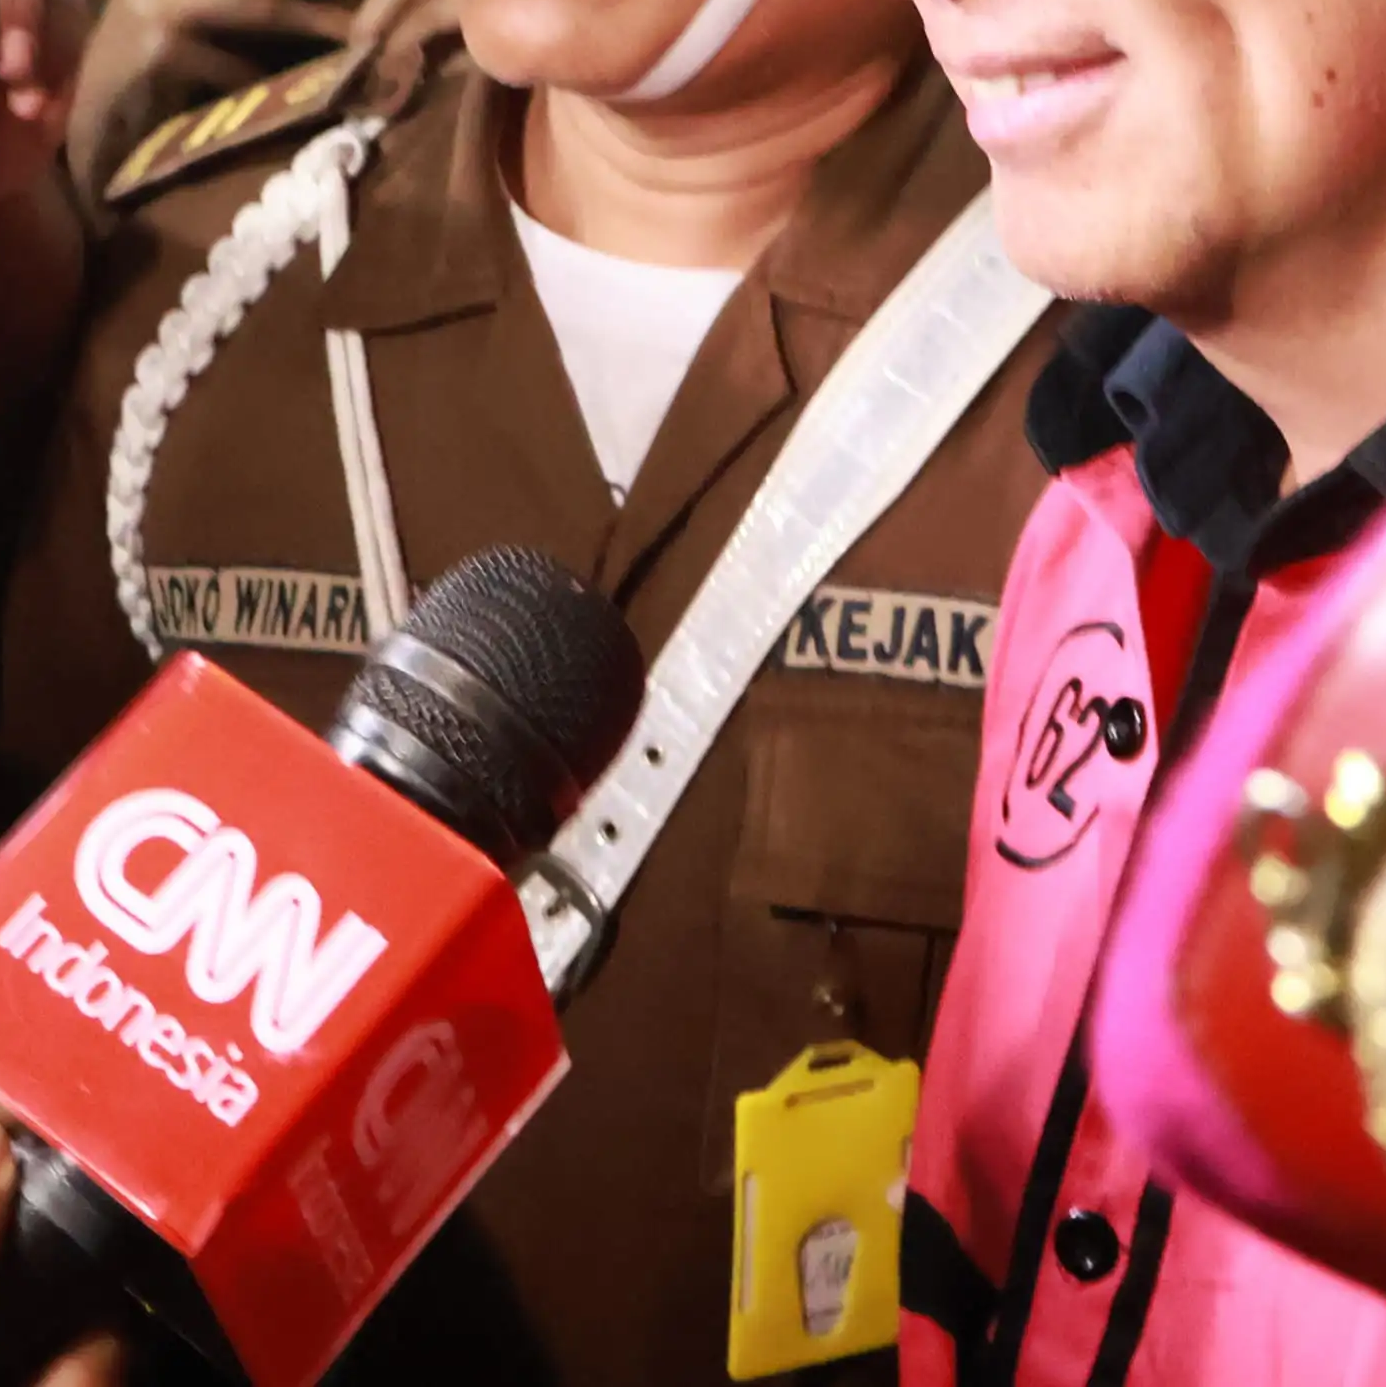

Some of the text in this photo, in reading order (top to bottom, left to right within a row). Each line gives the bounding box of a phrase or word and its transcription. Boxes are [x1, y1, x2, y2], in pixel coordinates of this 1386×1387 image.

[795, 596, 988, 677] KEJAK
[1026, 678, 1111, 821] 62
[74, 788, 388, 1054] CNN
